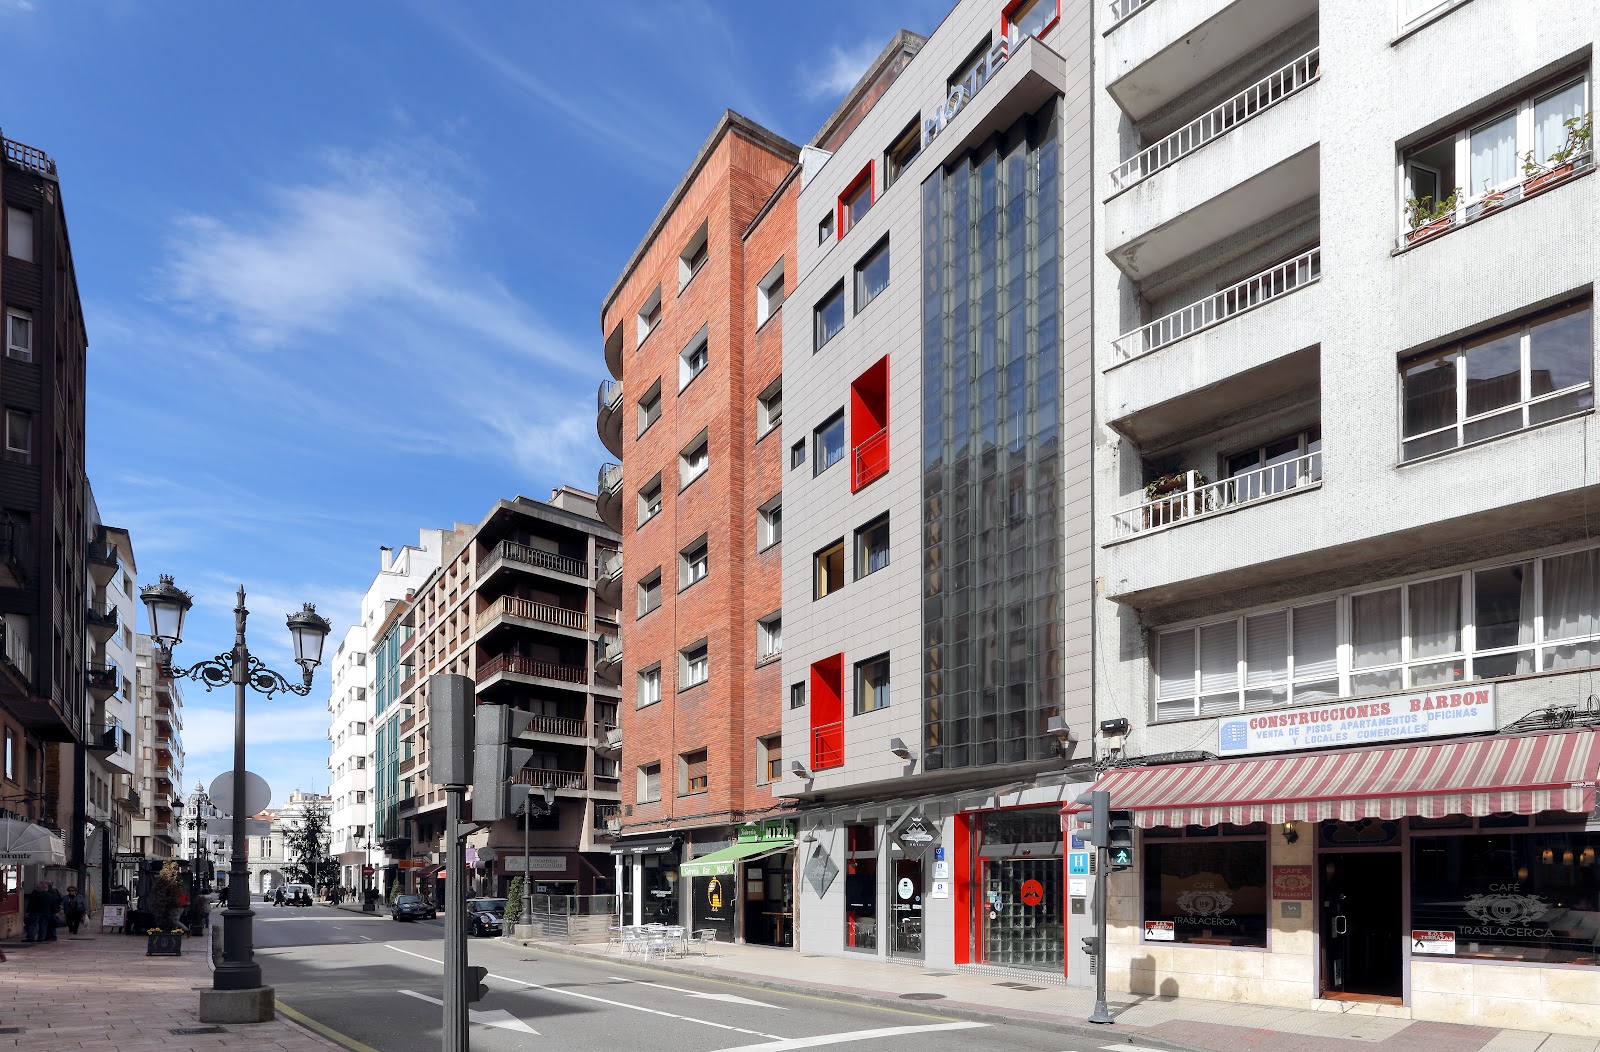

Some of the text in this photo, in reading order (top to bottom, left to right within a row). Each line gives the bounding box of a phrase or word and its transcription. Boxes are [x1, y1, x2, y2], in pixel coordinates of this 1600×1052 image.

[924, 23, 1028, 146] HOTEL
[1250, 690, 1489, 730] CONSTRUCCIONES BARBON
[1257, 708, 1478, 739] VENTA DE PISOS APARTAMENTOS OFICINAS
[1292, 724, 1428, 745] Y LOCALES COMERCIALES
[765, 826, 789, 839] NIZA
[1074, 855, 1083, 867] H
[1489, 882, 1521, 892] CAFÉ
[1174, 916, 1237, 926] TRASLACERCA
[1458, 925, 1555, 938] TRASLACERCA
